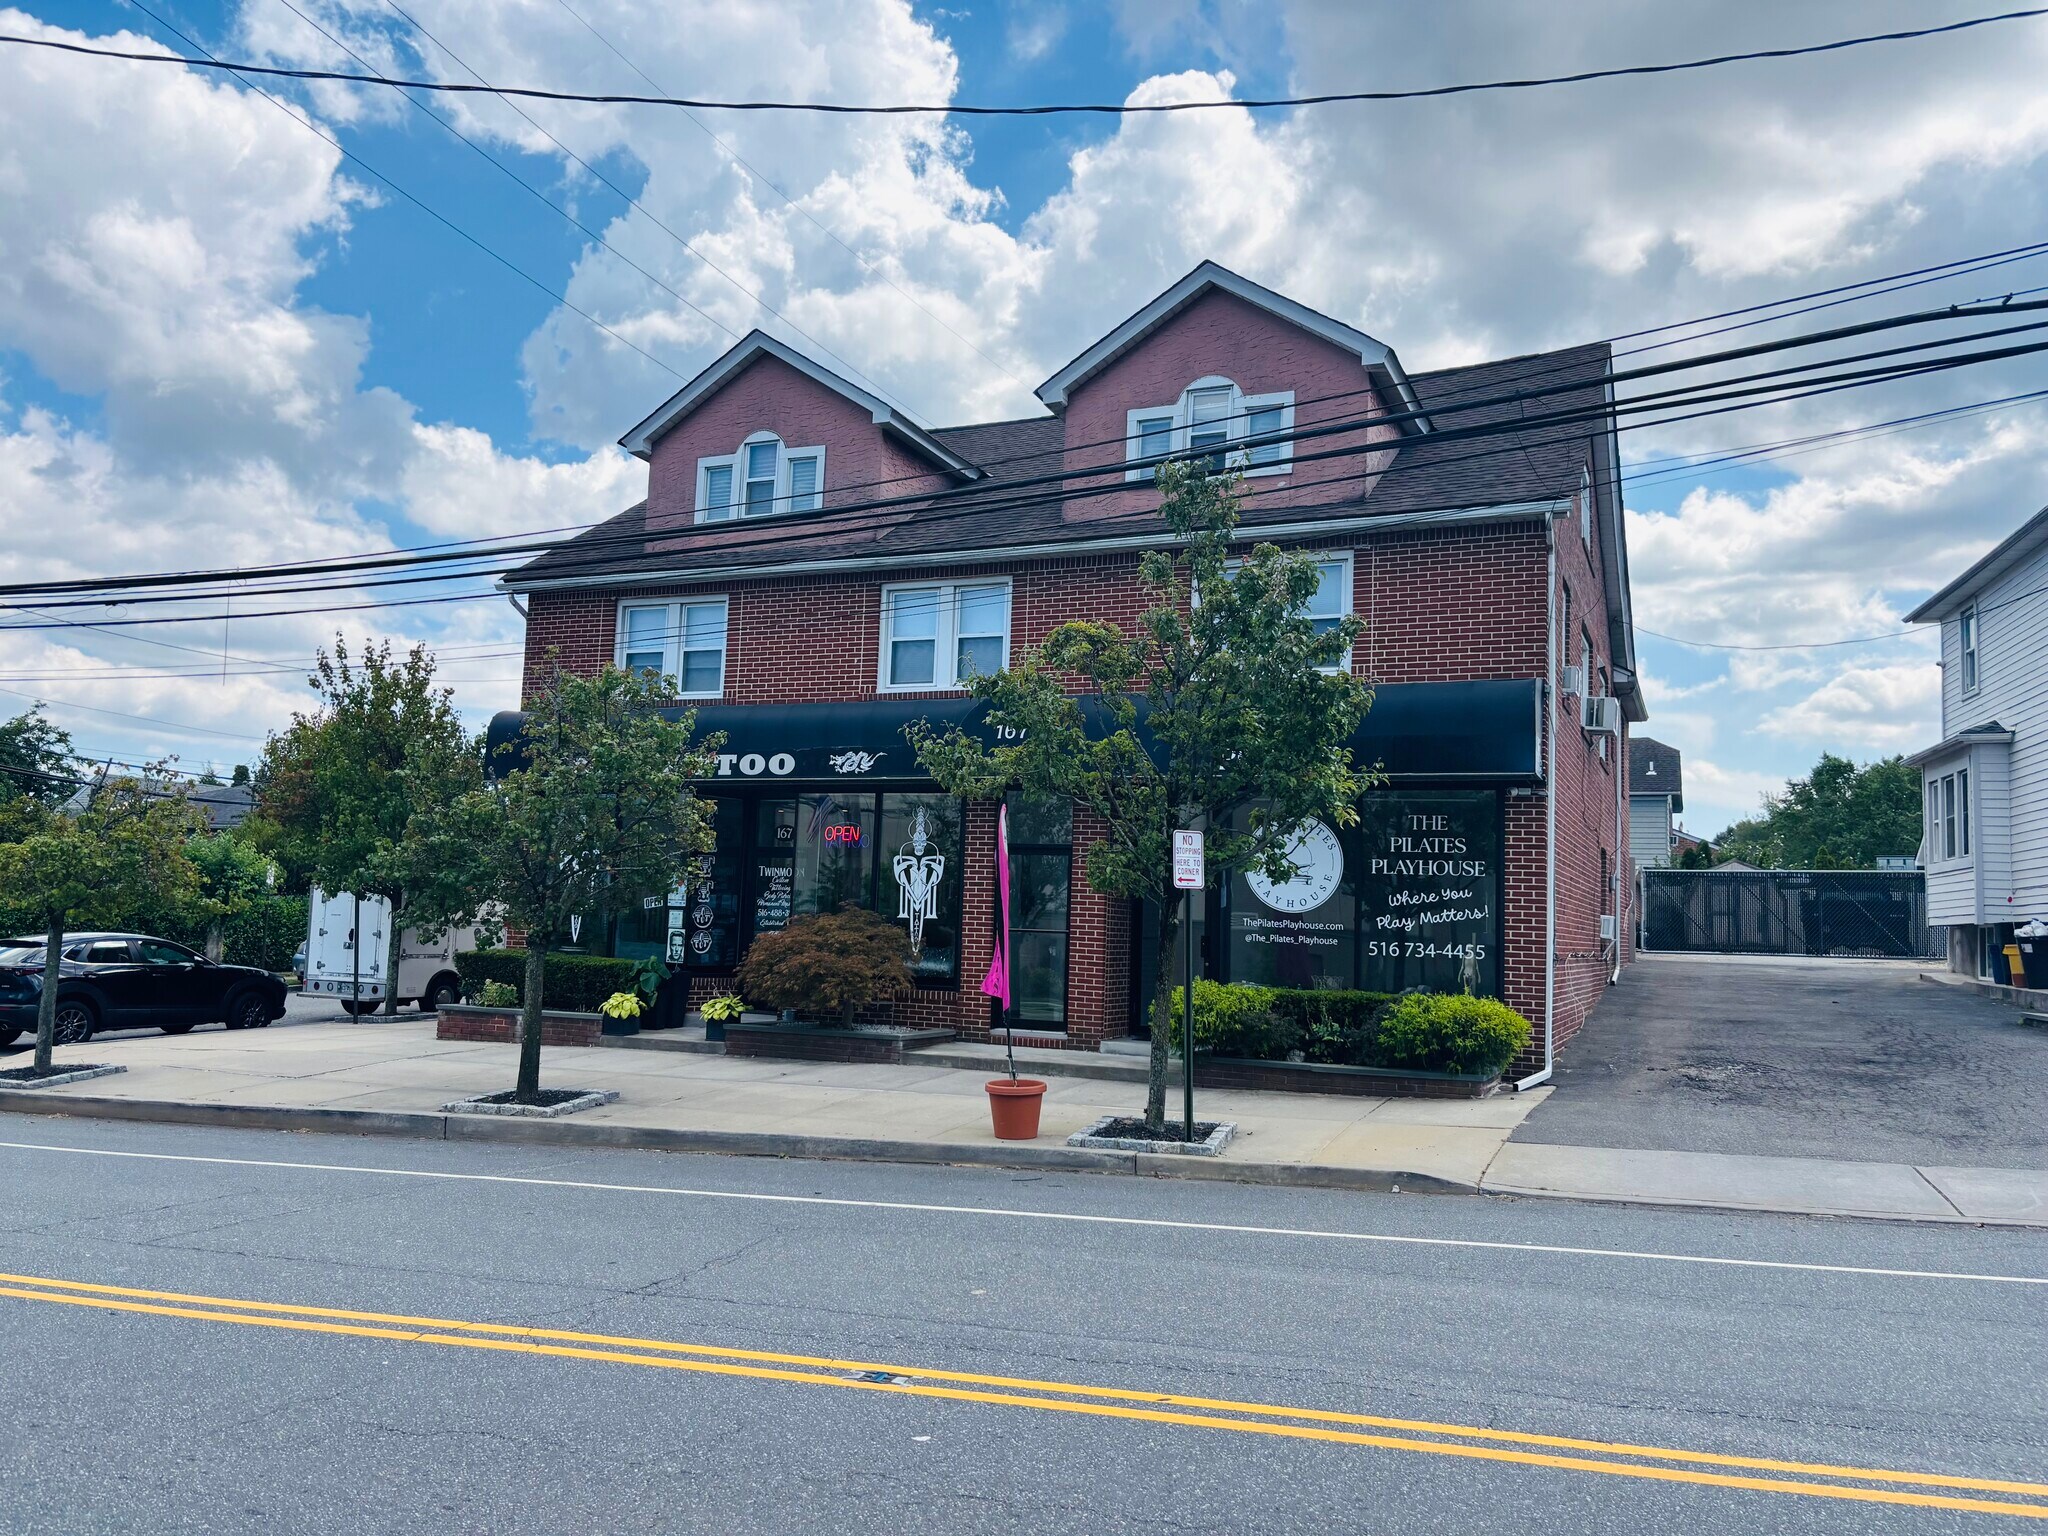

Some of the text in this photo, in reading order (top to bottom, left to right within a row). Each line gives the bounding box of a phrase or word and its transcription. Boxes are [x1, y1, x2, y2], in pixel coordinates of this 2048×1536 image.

[712, 753, 796, 776] TOO
[1408, 815, 1448, 831] THE
[777, 827, 793, 839] 167
[824, 826, 860, 841] OPEN
[1182, 835, 1193, 846] NO
[1390, 837, 1467, 853] PILATES
[1176, 847, 1201, 856] STOPPING
[1176, 859, 1201, 867] HERE TO
[1371, 859, 1486, 877] PLAYHOUSE
[1177, 867, 1200, 876] CORNER
[645, 896, 663, 908] OPEN
[1388, 888, 1472, 906] Where You
[1243, 918, 1344, 931] ThePilatesPlayhouse.com
[1376, 905, 1489, 931] Play Matters!
[1245, 933, 1338, 946] @The_Pilates_Playhouse
[1368, 941, 1486, 960] 516 734-4455
